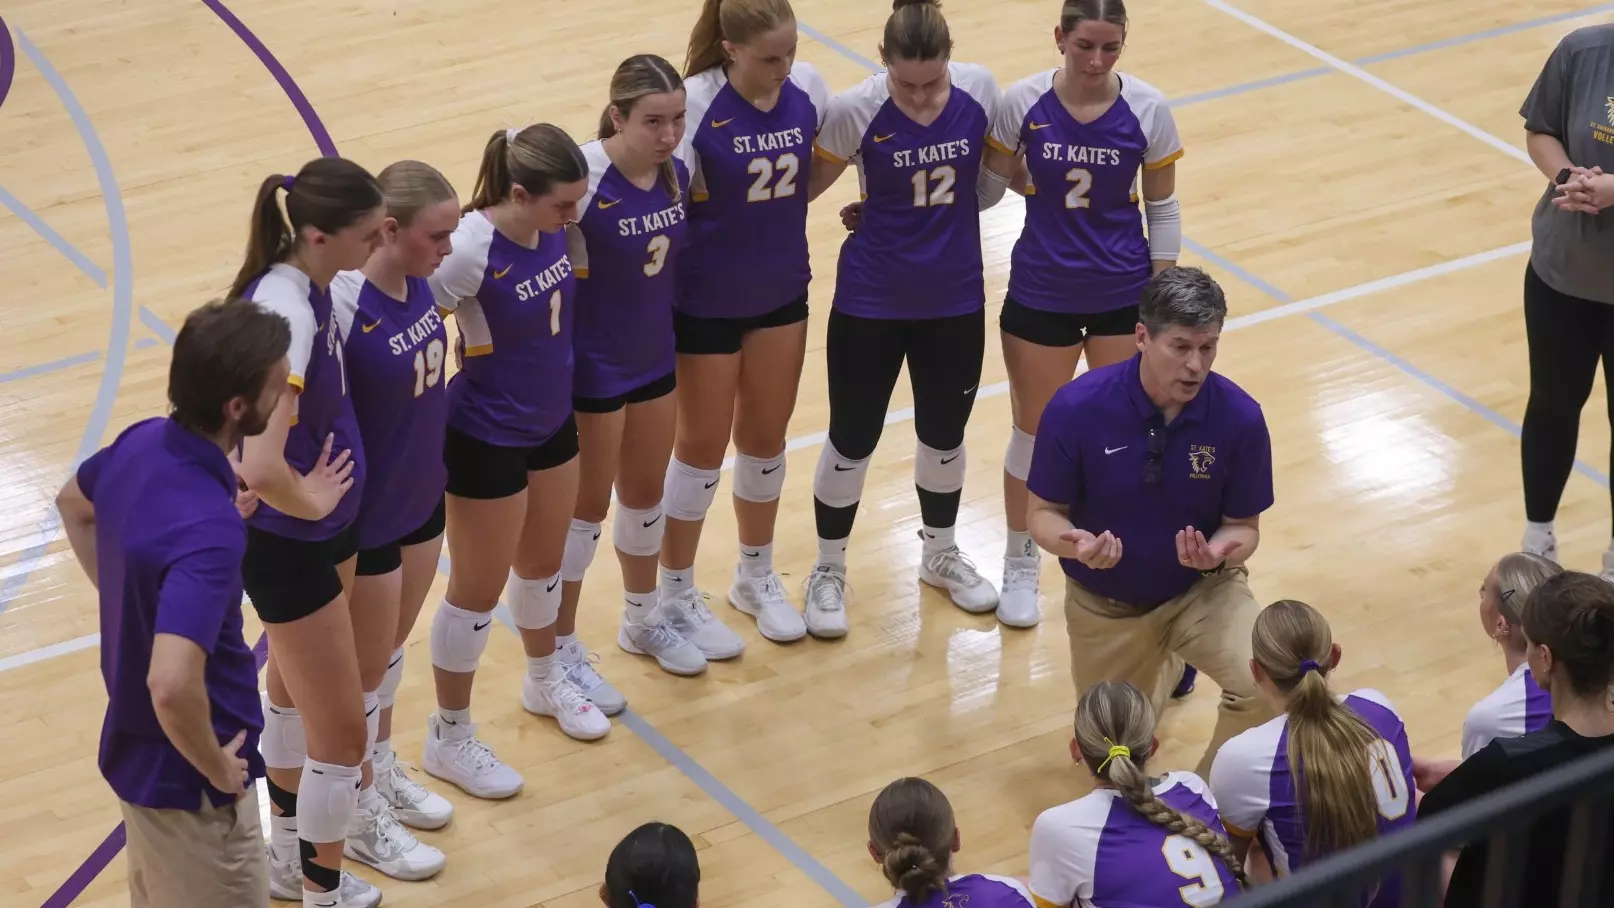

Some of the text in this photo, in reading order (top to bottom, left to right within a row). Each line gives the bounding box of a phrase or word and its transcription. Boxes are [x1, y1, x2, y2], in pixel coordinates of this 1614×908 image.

[733, 127, 804, 154] ST. KATE'S
[893, 139, 970, 168] ST. KATE'S
[1043, 142, 1120, 166] ST. KATE'S
[747, 152, 799, 203] 22
[911, 165, 956, 207] 12
[1065, 167, 1092, 209] 2
[618, 202, 685, 237] ST. KATE'S
[515, 254, 572, 301] ST. KATE'S
[643, 234, 670, 278] 3
[388, 304, 441, 356] ST. KATE'S
[549, 288, 562, 337] 1
[413, 338, 444, 399] 19
[1368, 738, 1409, 821] 0
[1161, 833, 1224, 908] 9
